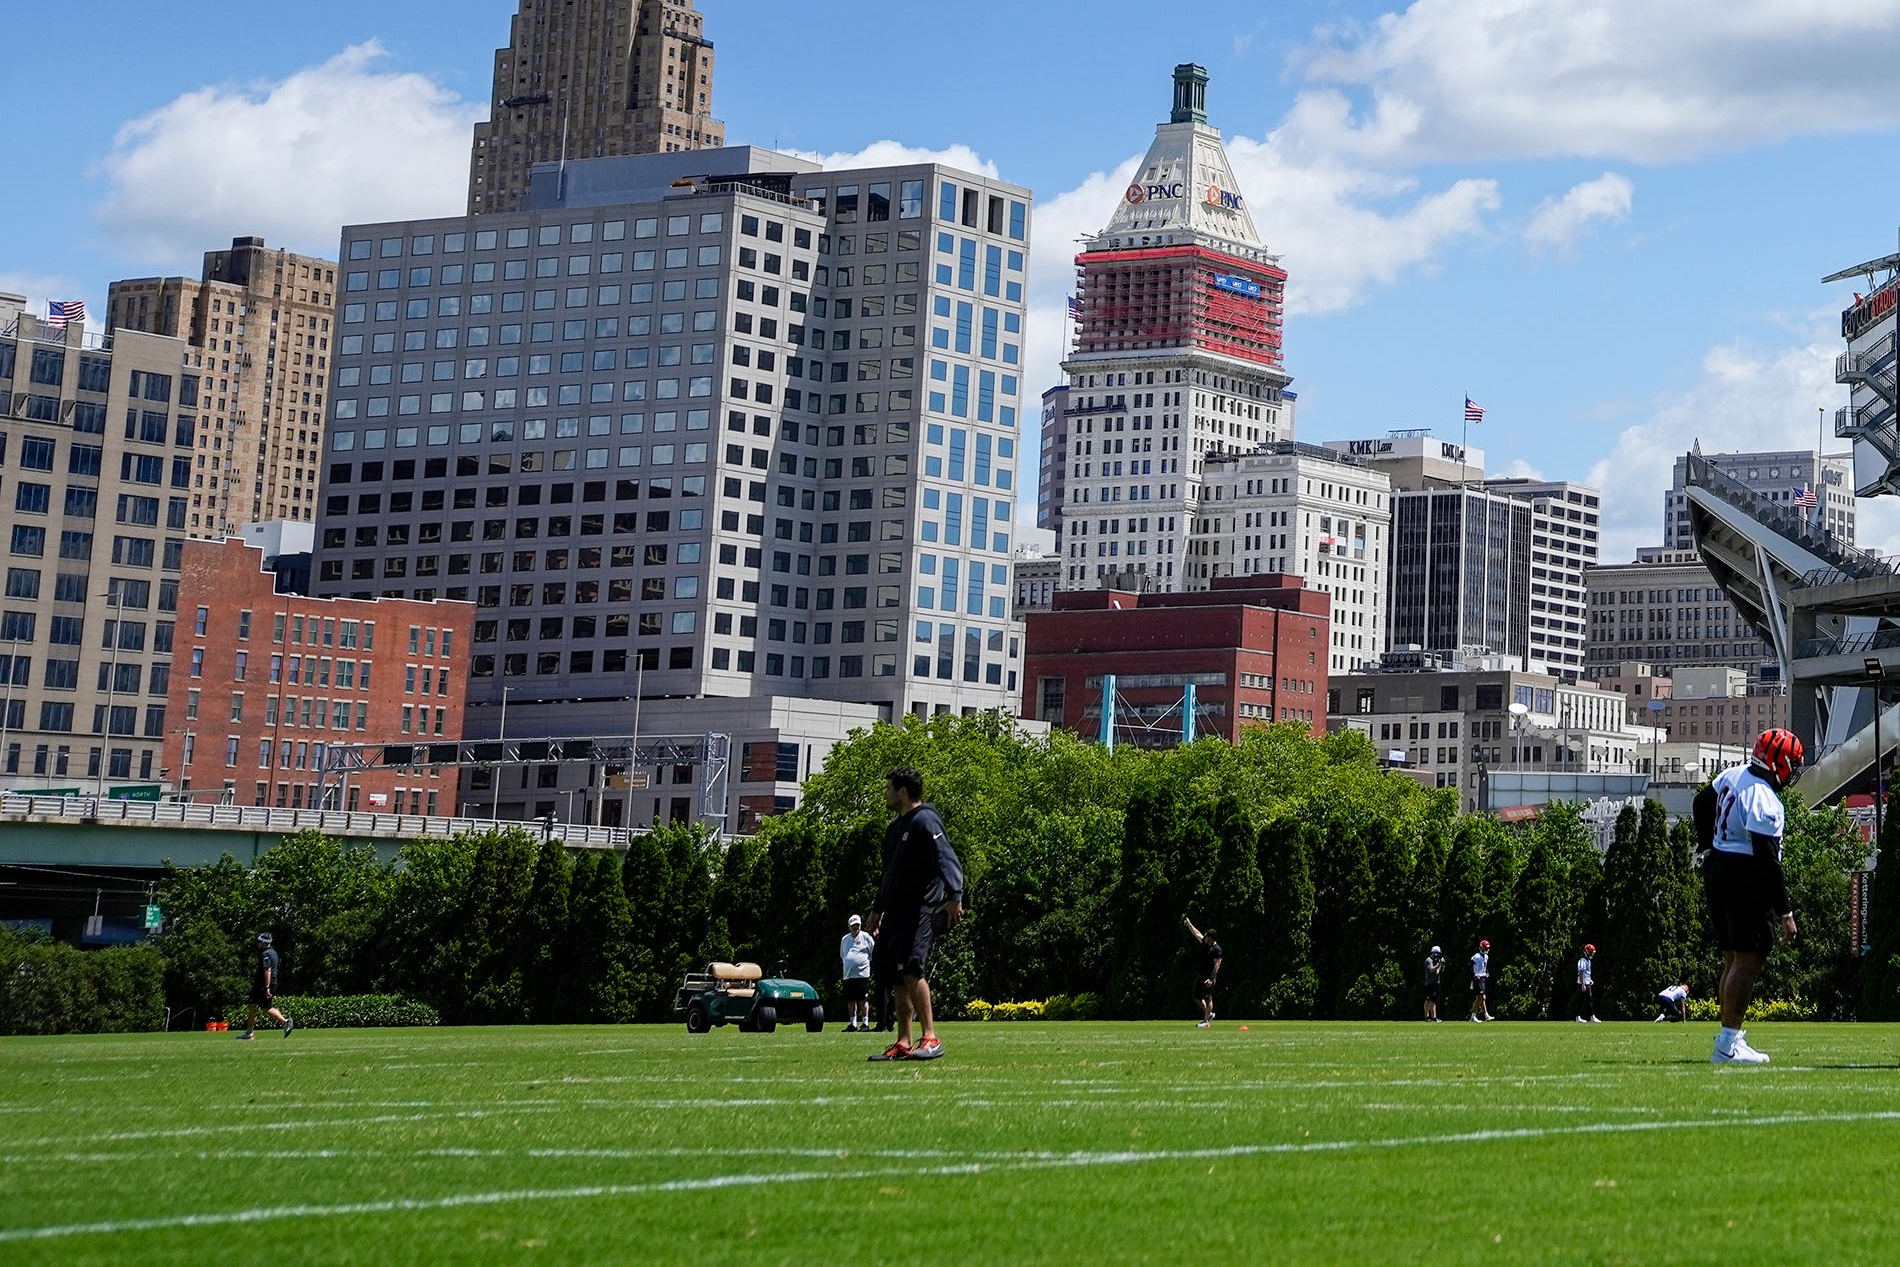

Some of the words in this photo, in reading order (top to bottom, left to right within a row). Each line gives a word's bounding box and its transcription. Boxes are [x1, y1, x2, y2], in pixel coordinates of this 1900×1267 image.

[1146, 183, 1183, 200] PNC
[1219, 189, 1243, 210] PNC
[1871, 286, 1898, 317] STADIU
[1350, 440, 1372, 455] KMK
[1442, 442, 1455, 459] KMK
